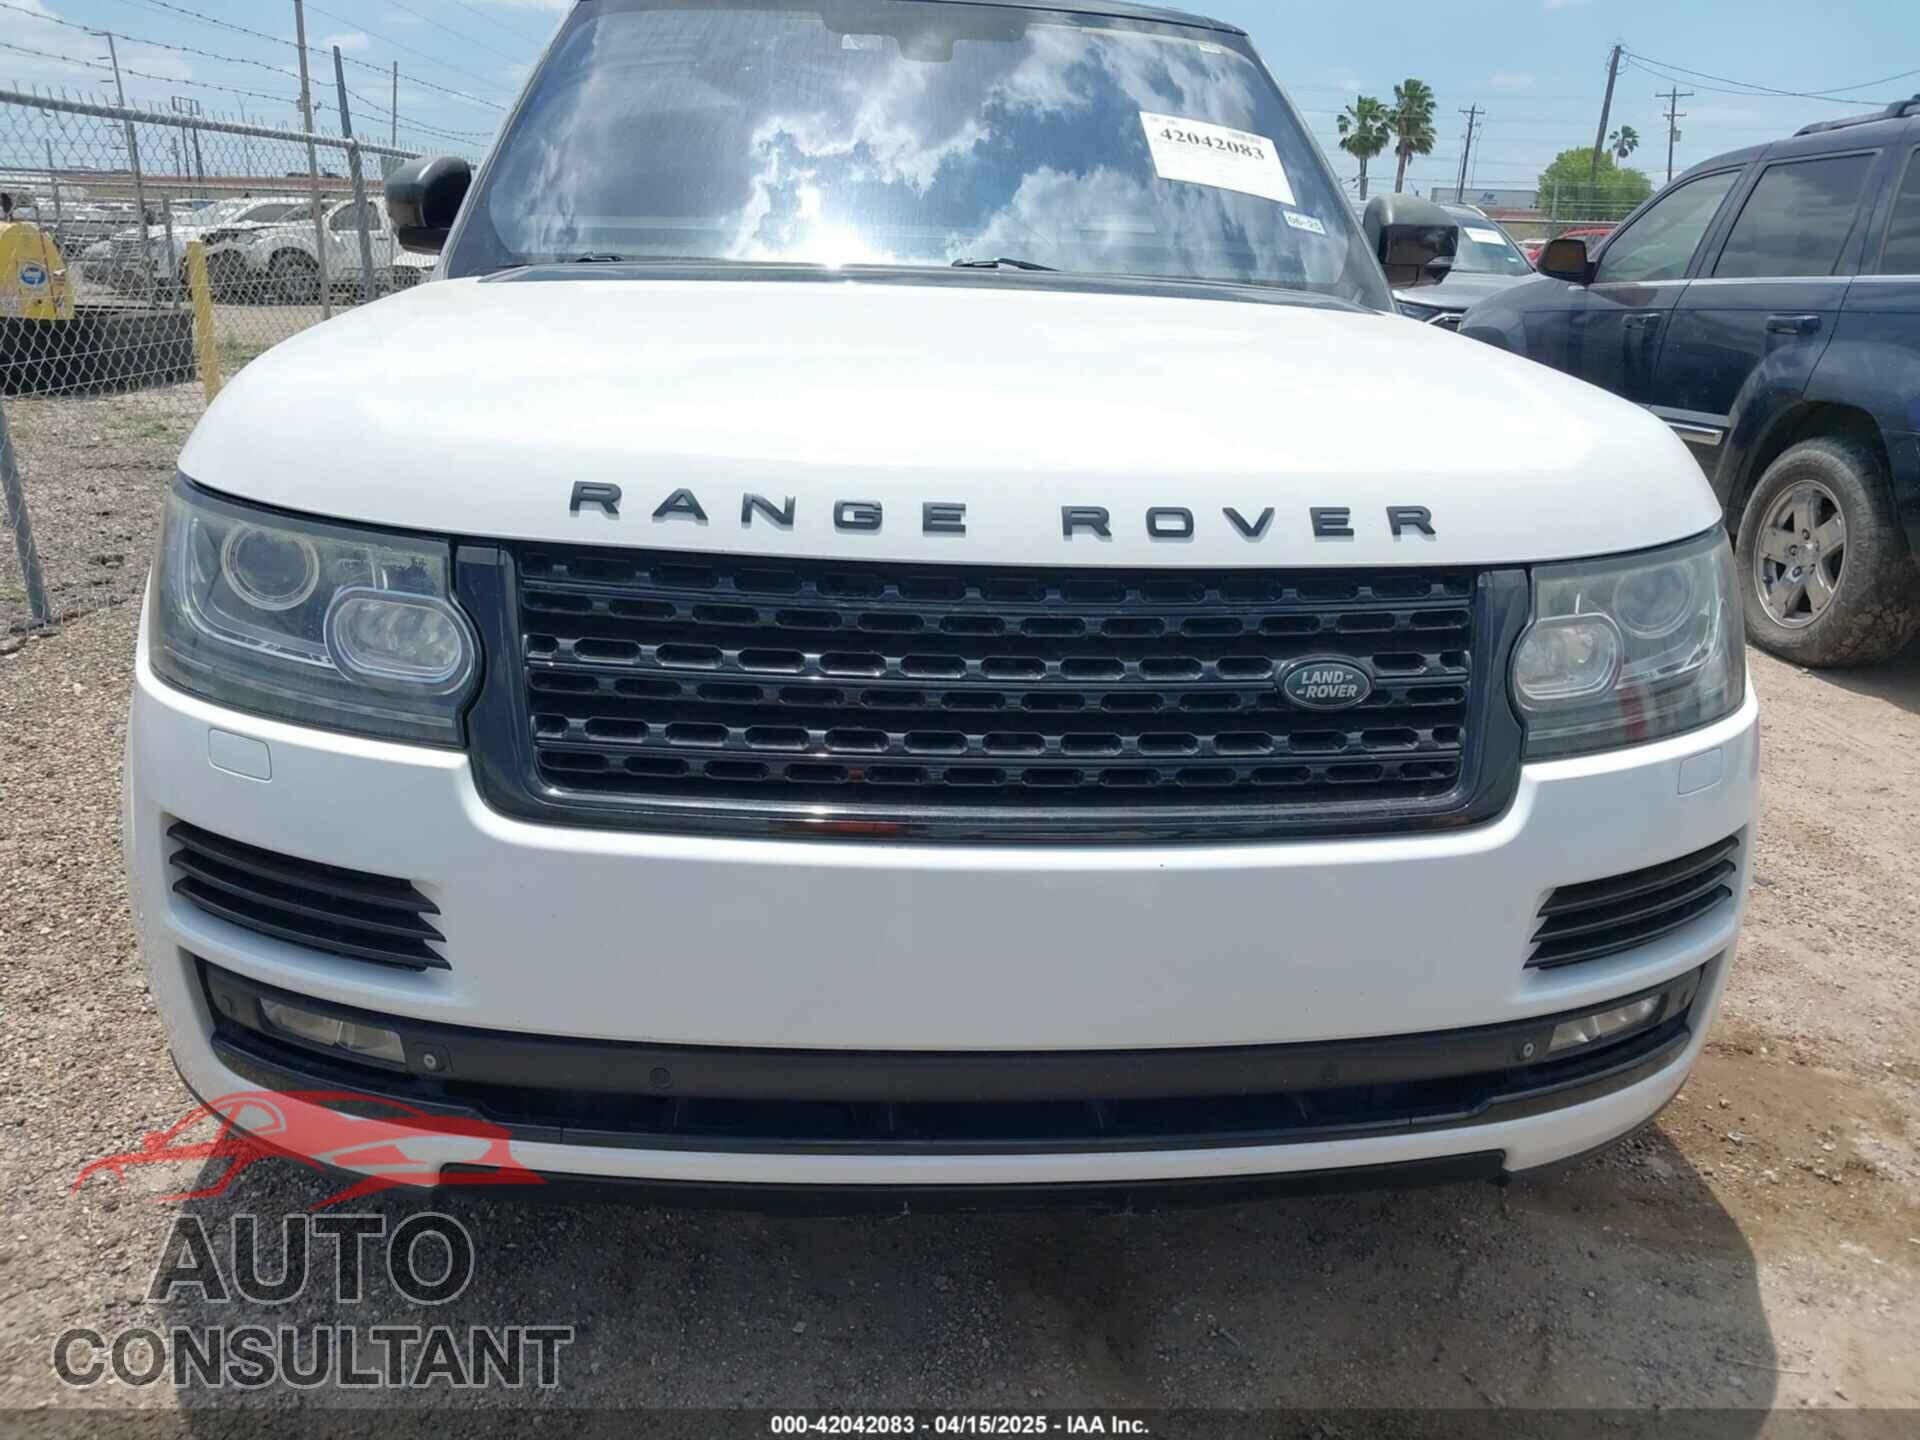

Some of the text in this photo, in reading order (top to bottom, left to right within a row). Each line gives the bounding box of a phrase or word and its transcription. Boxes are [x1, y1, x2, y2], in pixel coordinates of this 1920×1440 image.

[1160, 128, 1265, 160] 42042083
[570, 480, 1437, 540] RANGE ROVER
